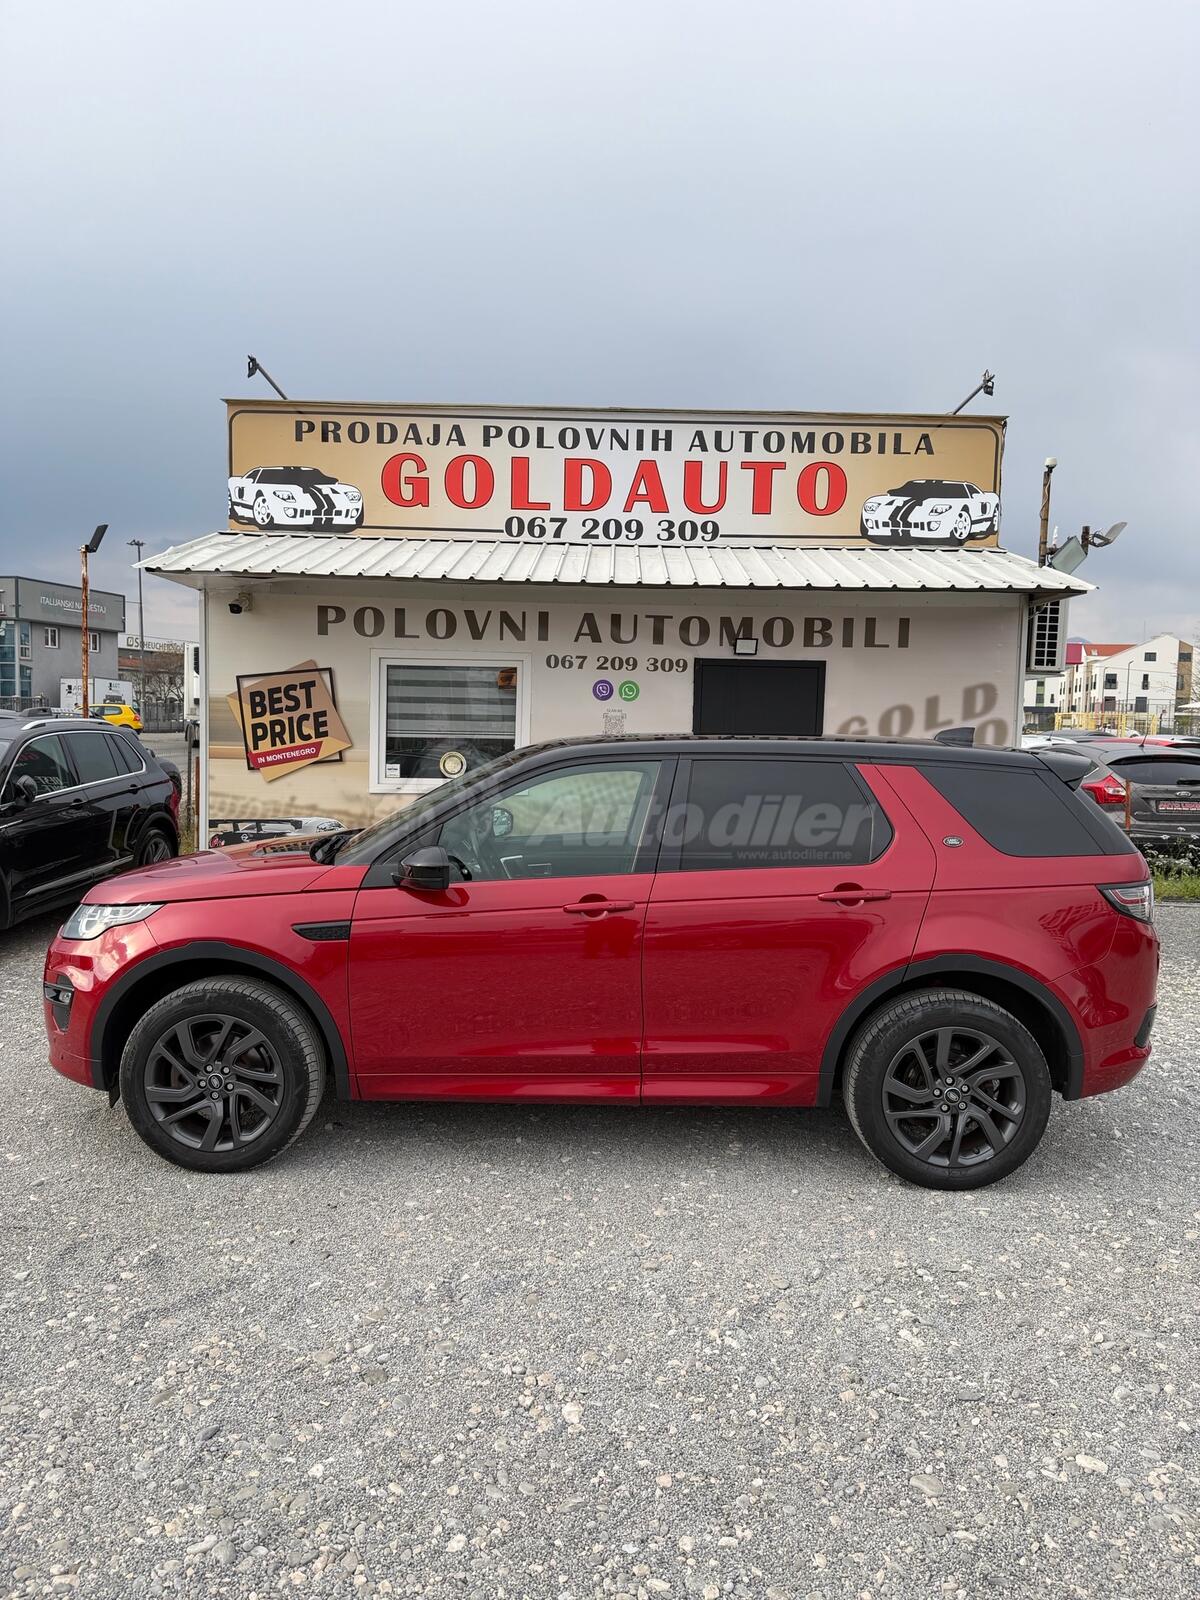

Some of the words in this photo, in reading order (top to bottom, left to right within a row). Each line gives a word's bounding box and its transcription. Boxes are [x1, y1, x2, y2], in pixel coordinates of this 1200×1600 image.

[294, 419, 467, 448] PRODAJA
[482, 425, 673, 452] POLOVNIH
[688, 429, 935, 456] AUTOMOBILA
[380, 452, 848, 517] GOLDAUTO
[504, 516, 568, 539] 067
[581, 517, 644, 541] 209
[656, 519, 721, 543] 309
[316, 604, 549, 642] POLOVNI
[573, 612, 911, 650] AUTOMOBILI
[545, 654, 588, 670] 067
[596, 655, 638, 671] 209
[646, 657, 688, 673] 309
[249, 680, 316, 719] BEST
[251, 710, 329, 751] PRICE
[257, 756, 266, 764] IN
[266, 747, 316, 762] MONTENEGRO
